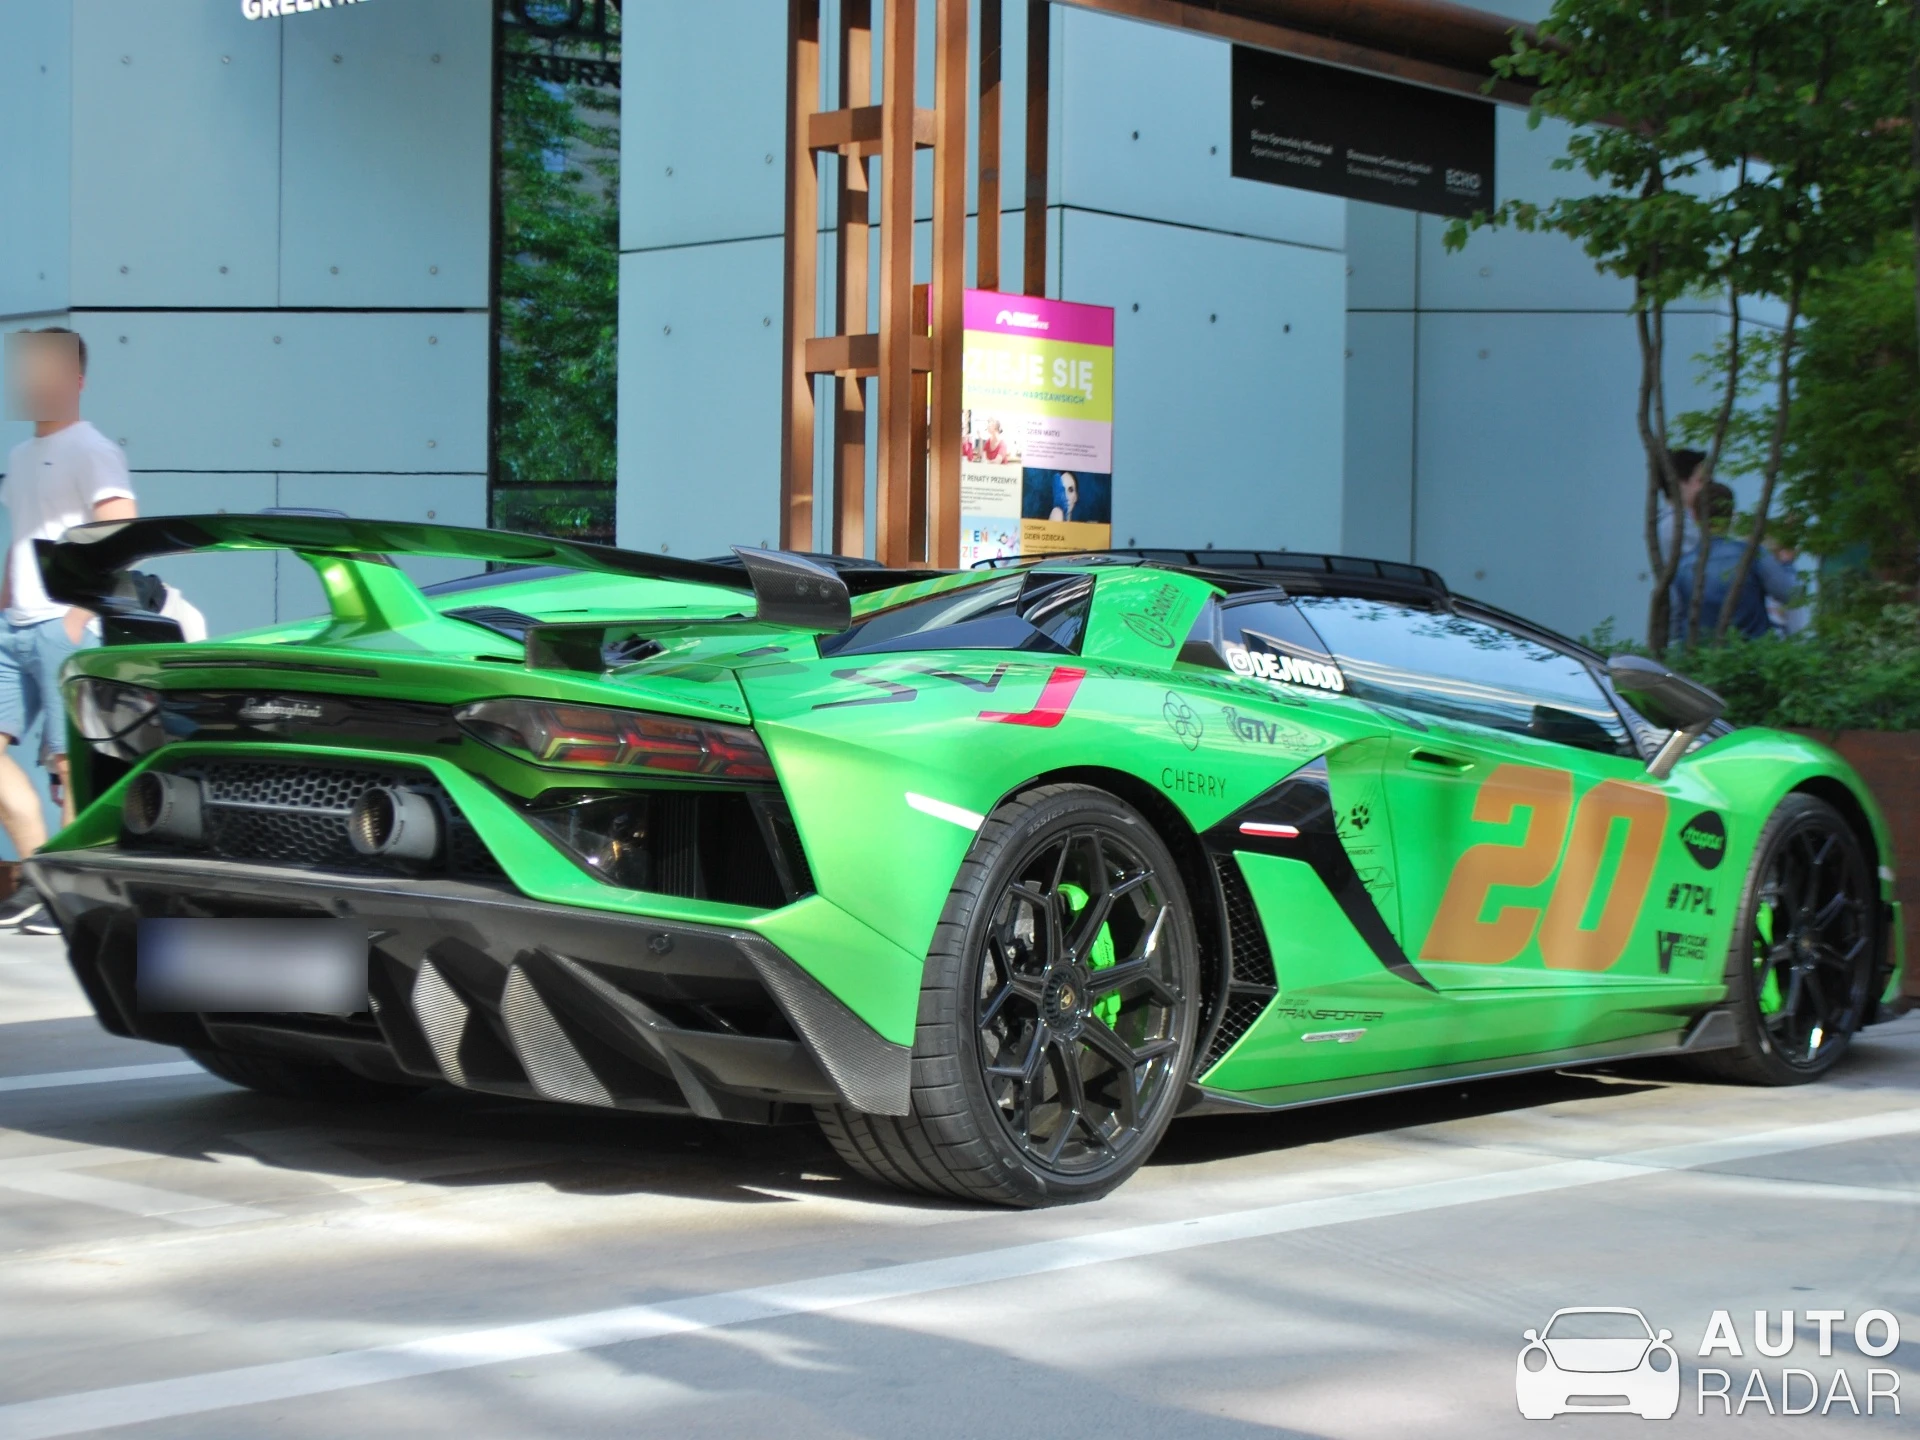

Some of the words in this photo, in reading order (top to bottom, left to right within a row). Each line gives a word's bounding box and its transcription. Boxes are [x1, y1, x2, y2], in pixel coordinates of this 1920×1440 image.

[1445, 168, 1481, 189] ECHO
[963, 348, 1044, 386] ZIEJE
[1051, 357, 1094, 400] SIĘ
[1236, 716, 1278, 745] GTV
[1161, 767, 1227, 799] CHERRY
[1418, 763, 1671, 972] 20
[1277, 1008, 1385, 1022] TRANSPORTER
